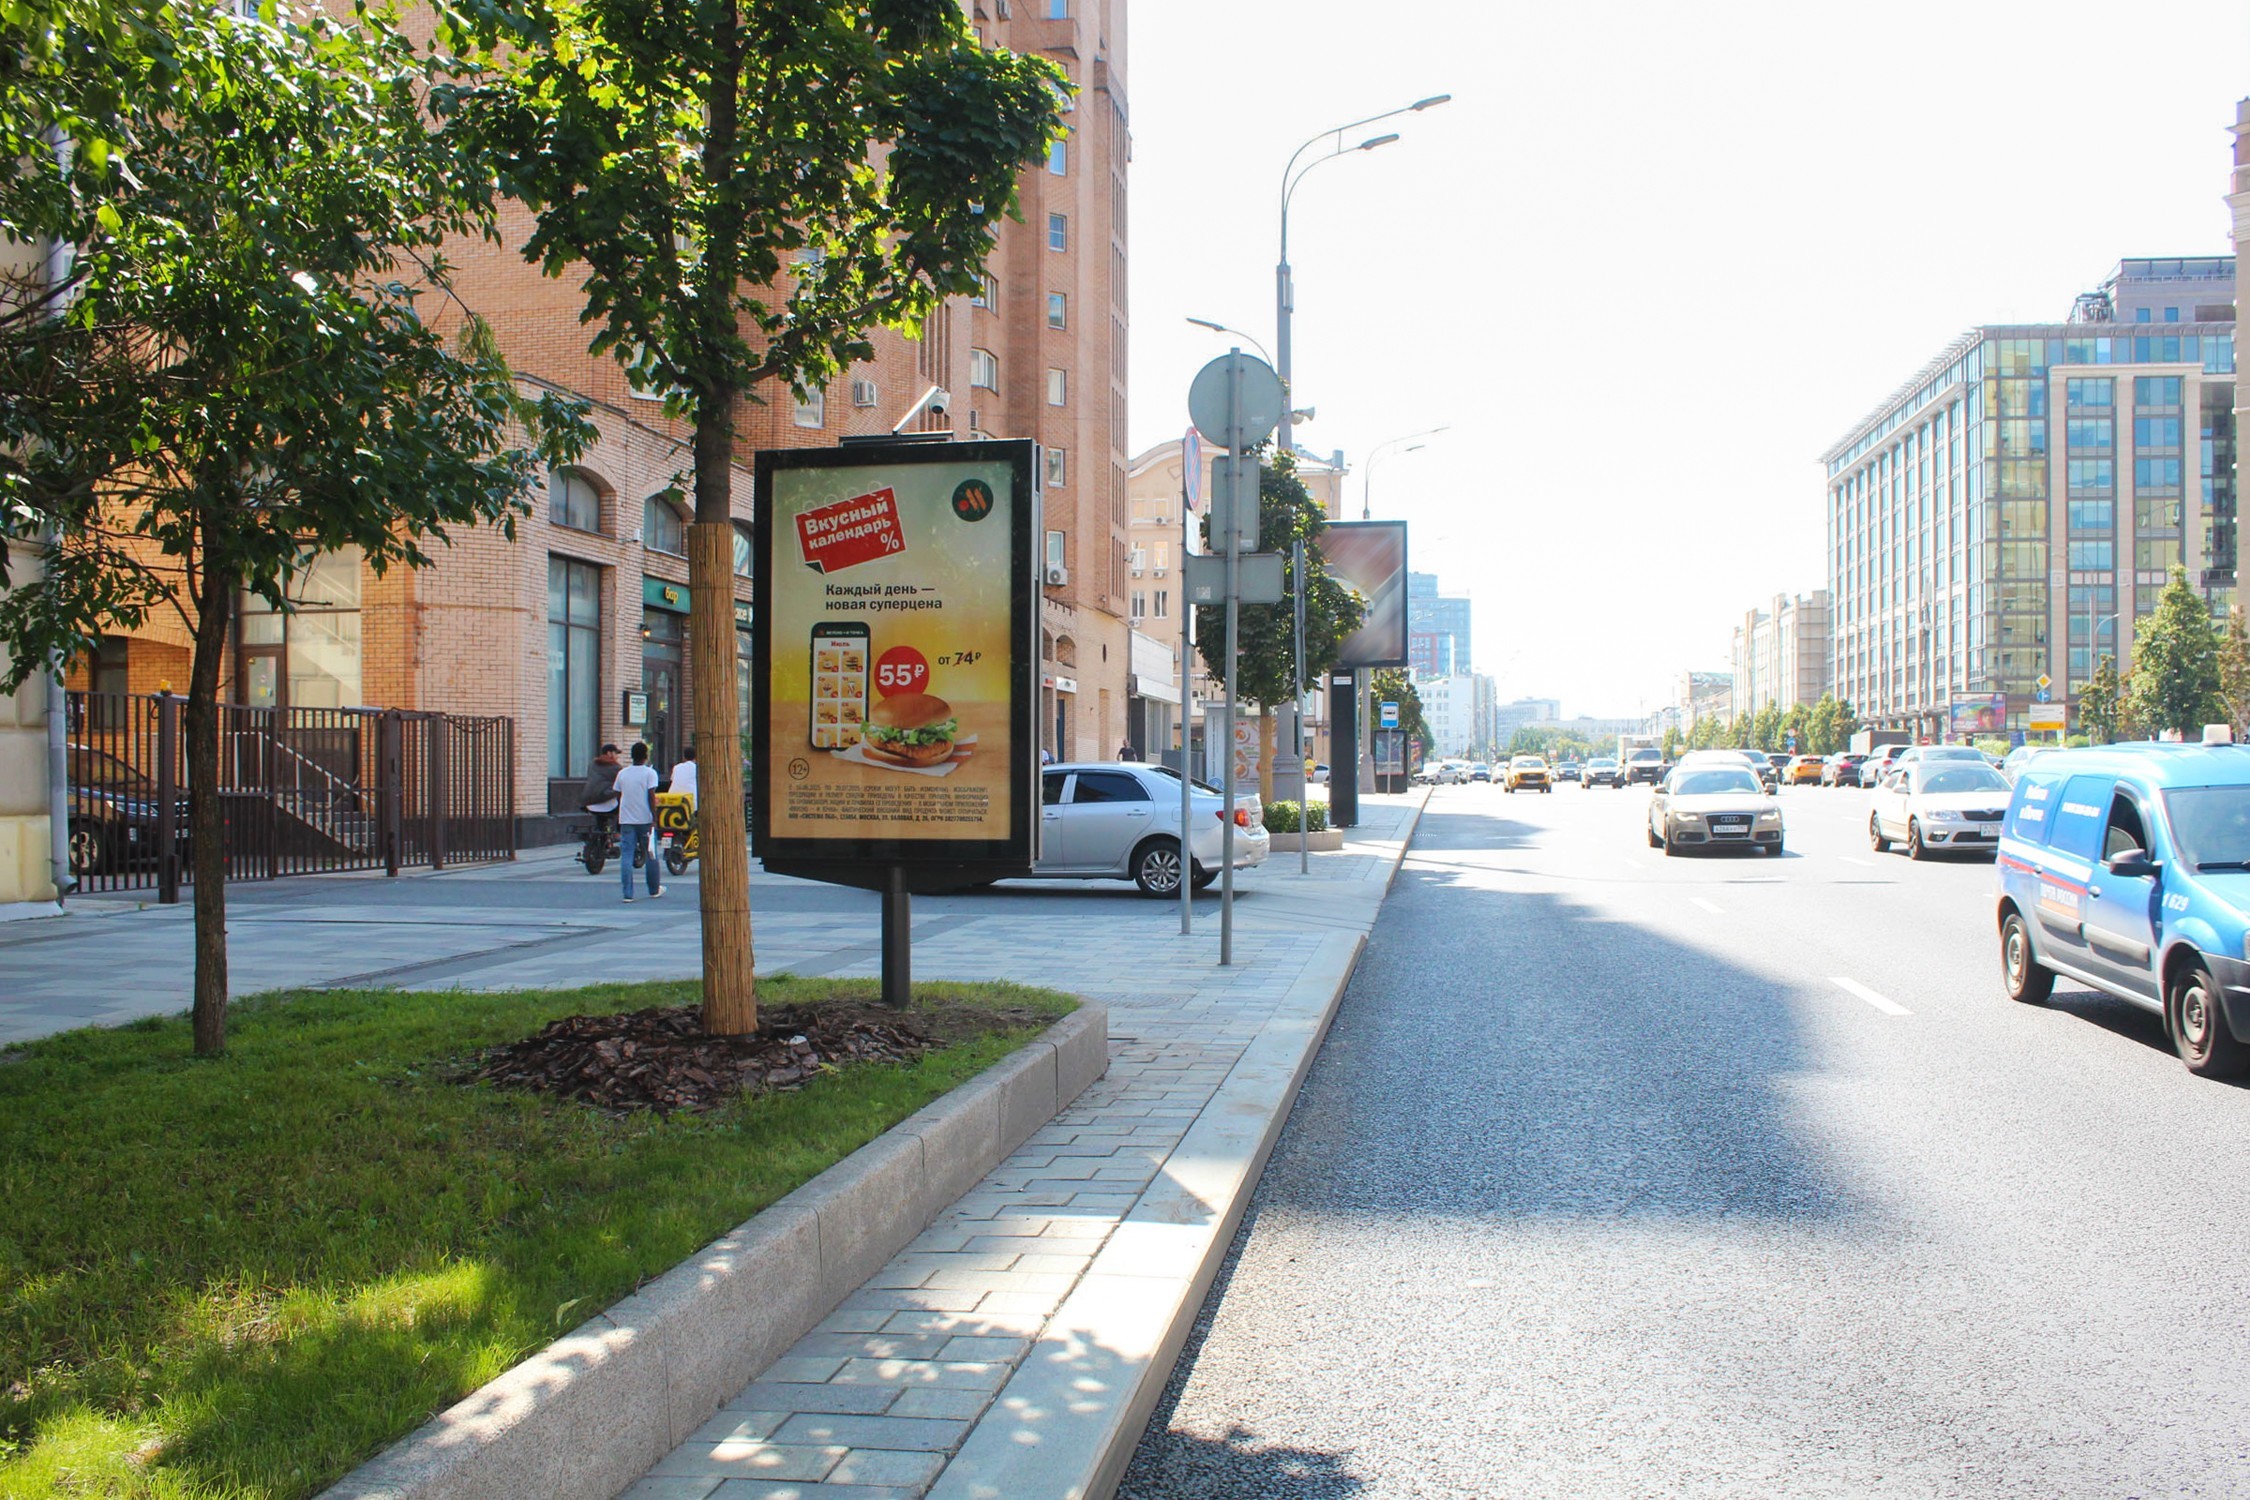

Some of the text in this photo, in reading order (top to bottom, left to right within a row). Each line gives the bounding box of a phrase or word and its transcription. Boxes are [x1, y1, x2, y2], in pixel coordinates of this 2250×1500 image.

[805, 497, 888, 535] Вкусный
[808, 518, 891, 549] календарь
[880, 530, 899, 552] %
[826, 584, 881, 597] Каждый
[885, 585, 917, 596] день
[825, 600, 942, 611] новая суперцена
[938, 656, 950, 665] от
[879, 664, 925, 686] 55₽
[792, 763, 807, 775] 12+
